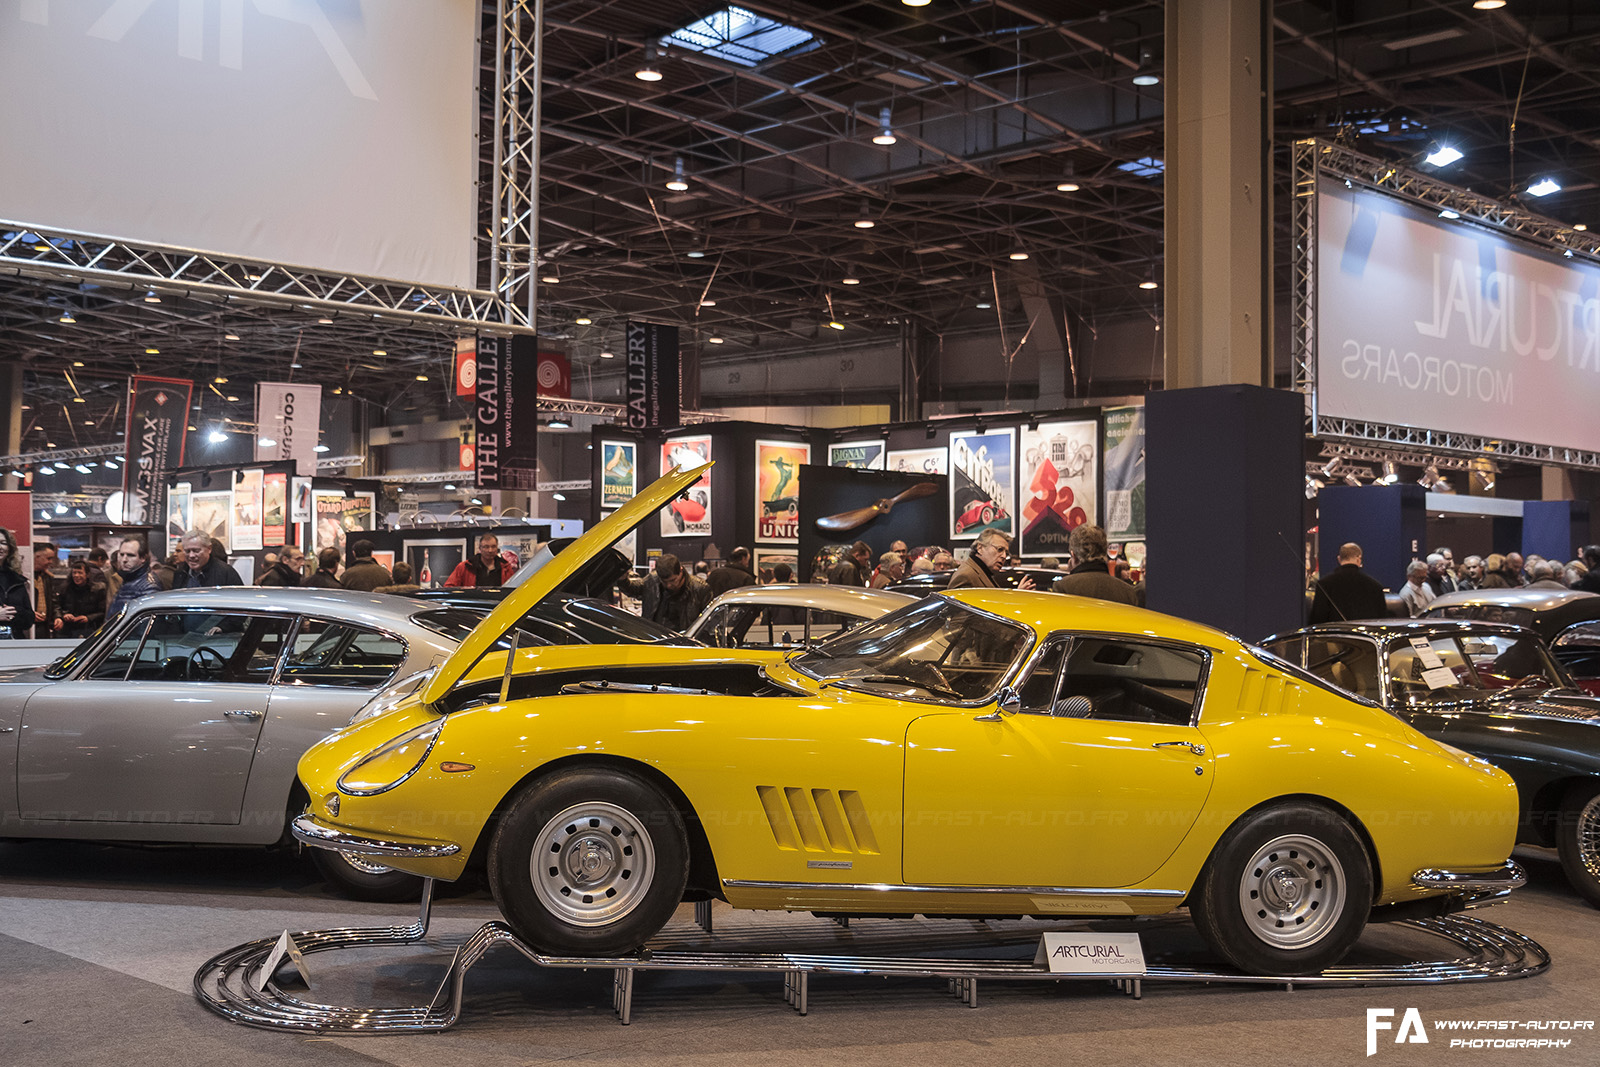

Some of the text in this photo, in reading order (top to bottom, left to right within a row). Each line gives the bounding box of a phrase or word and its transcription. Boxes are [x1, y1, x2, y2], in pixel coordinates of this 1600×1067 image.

[841, 360, 854, 372] 30
[628, 322, 646, 429] GALLERY
[728, 372, 741, 384] 29
[478, 433, 498, 486] THE
[832, 448, 866, 462] BIGNAN
[604, 485, 633, 495] ZERMATT
[1040, 533, 1070, 543] OPTIM
